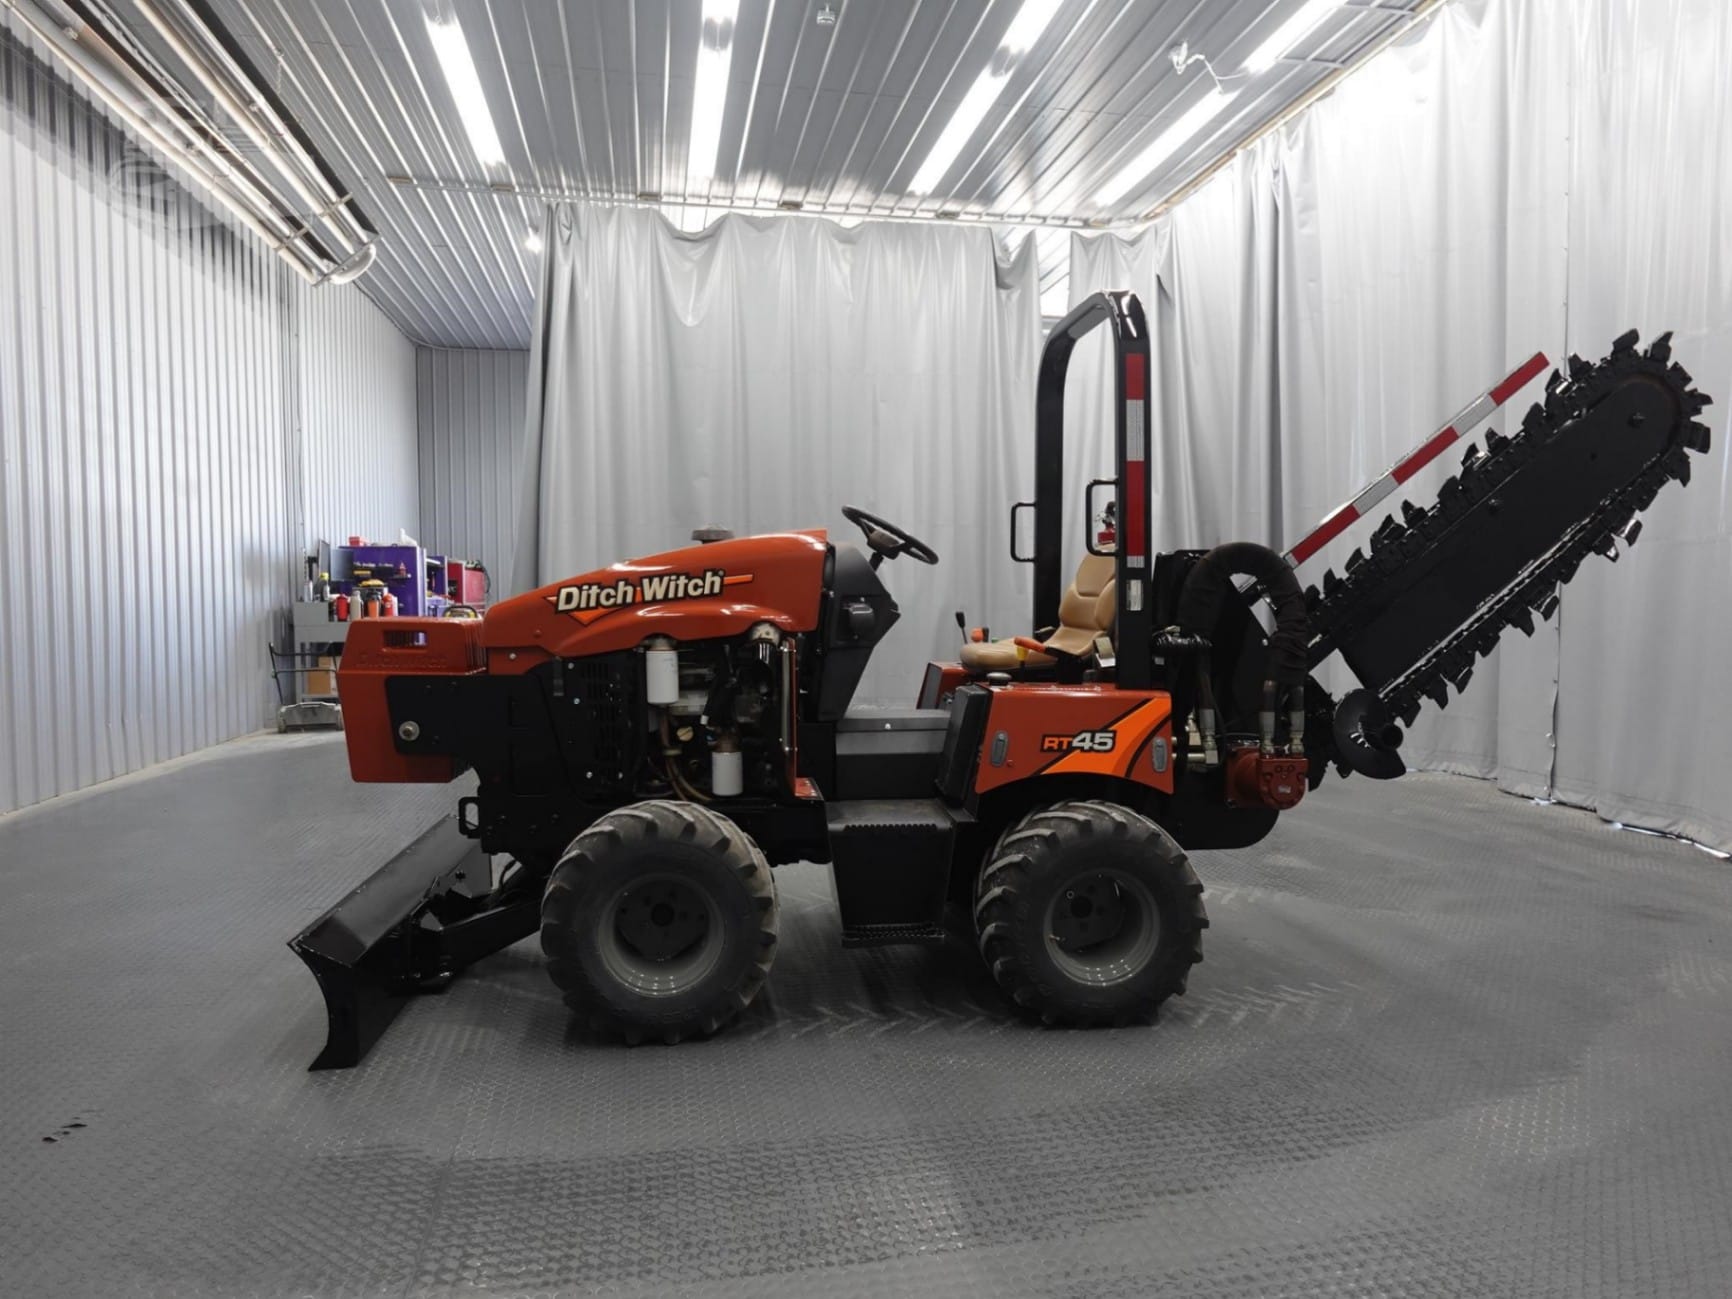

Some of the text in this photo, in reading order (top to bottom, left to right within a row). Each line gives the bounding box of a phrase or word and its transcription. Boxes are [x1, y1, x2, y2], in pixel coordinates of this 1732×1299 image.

[557, 570, 722, 612] Ditch Witch
[1043, 731, 1114, 751] RT45
